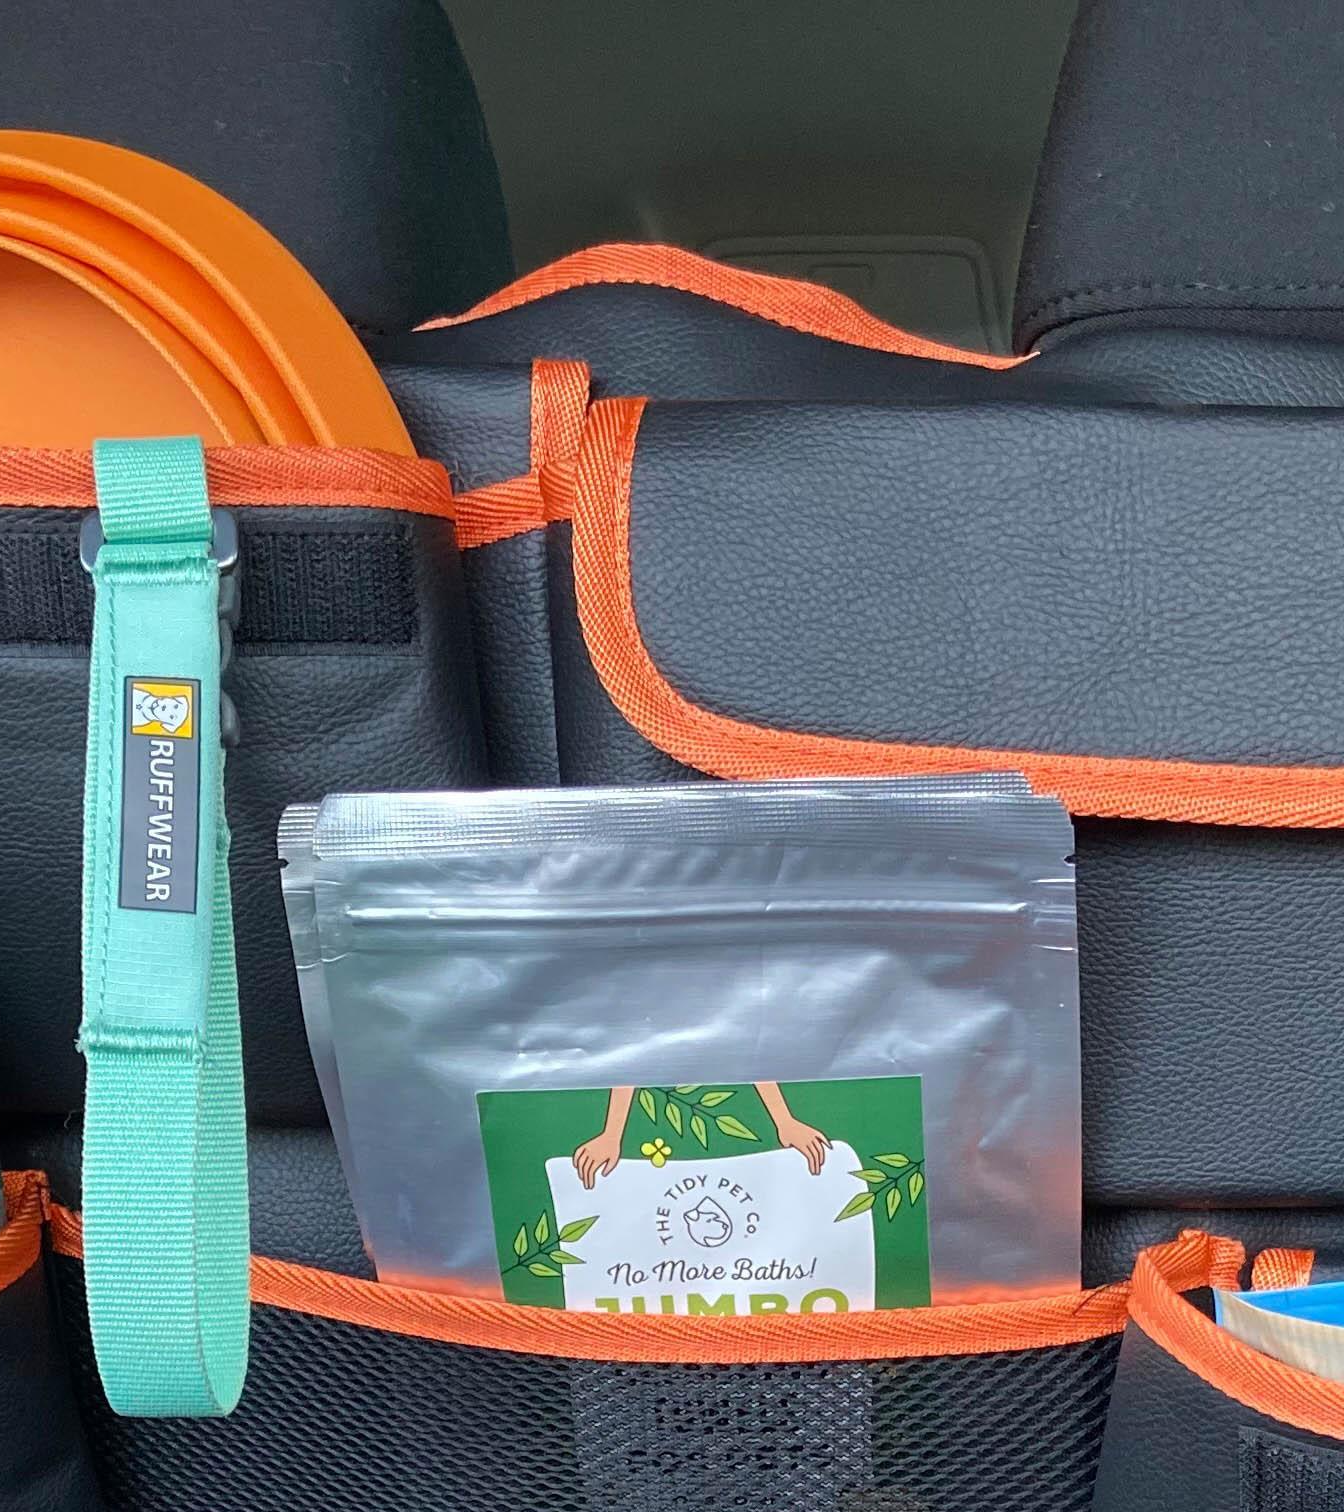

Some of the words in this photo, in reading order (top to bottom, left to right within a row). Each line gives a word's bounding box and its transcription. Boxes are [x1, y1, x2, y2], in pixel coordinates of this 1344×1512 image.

[145, 740, 174, 901] RUFFWEAR
[664, 1174, 708, 1200] TIDY
[718, 1177, 753, 1204] PET
[656, 1207, 673, 1245] THE
[607, 1262, 648, 1286] No
[652, 1259, 726, 1283] More
[731, 1257, 817, 1280] Baths!
